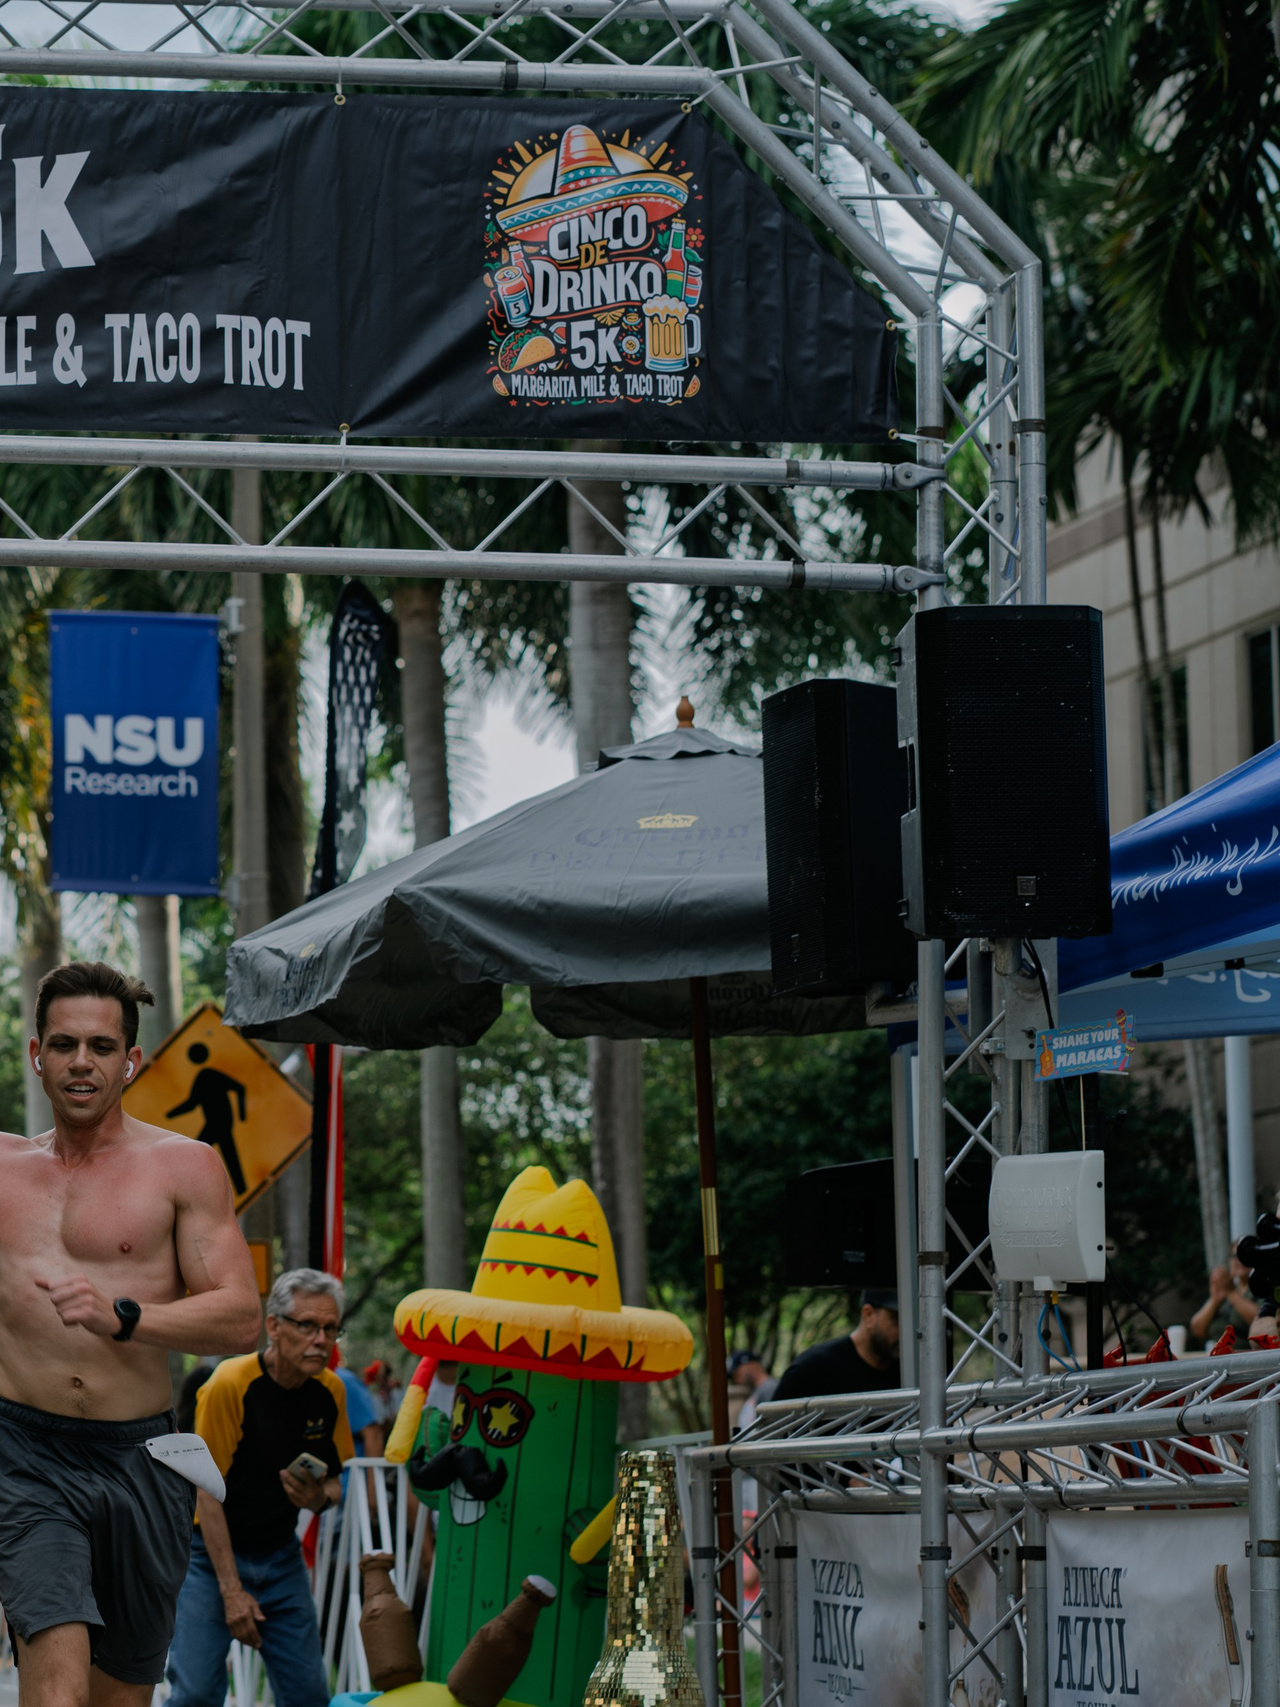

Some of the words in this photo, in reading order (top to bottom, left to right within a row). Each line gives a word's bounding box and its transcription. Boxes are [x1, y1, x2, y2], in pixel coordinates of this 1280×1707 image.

[548, 204, 647, 261] CINCO
[578, 239, 610, 269] DE
[513, 302, 521, 314] 5
[529, 259, 662, 317] DRINKO
[52, 313, 88, 388] &
[105, 312, 201, 383] TACO
[215, 313, 311, 391] TROT
[570, 319, 622, 369] 5K
[511, 374, 577, 398] MARGARITA
[581, 374, 606, 397] MILE
[609, 374, 620, 397] &
[624, 373, 652, 396] TACO
[656, 374, 684, 398] TROT
[64, 713, 205, 768] NSU
[64, 766, 199, 798] Research
[1052, 1032, 1089, 1049] SHAKE
[1090, 1028, 1120, 1045] YOUR
[1055, 1045, 1122, 1068] MARACAS
[1054, 1615, 1140, 1695] AZUL
